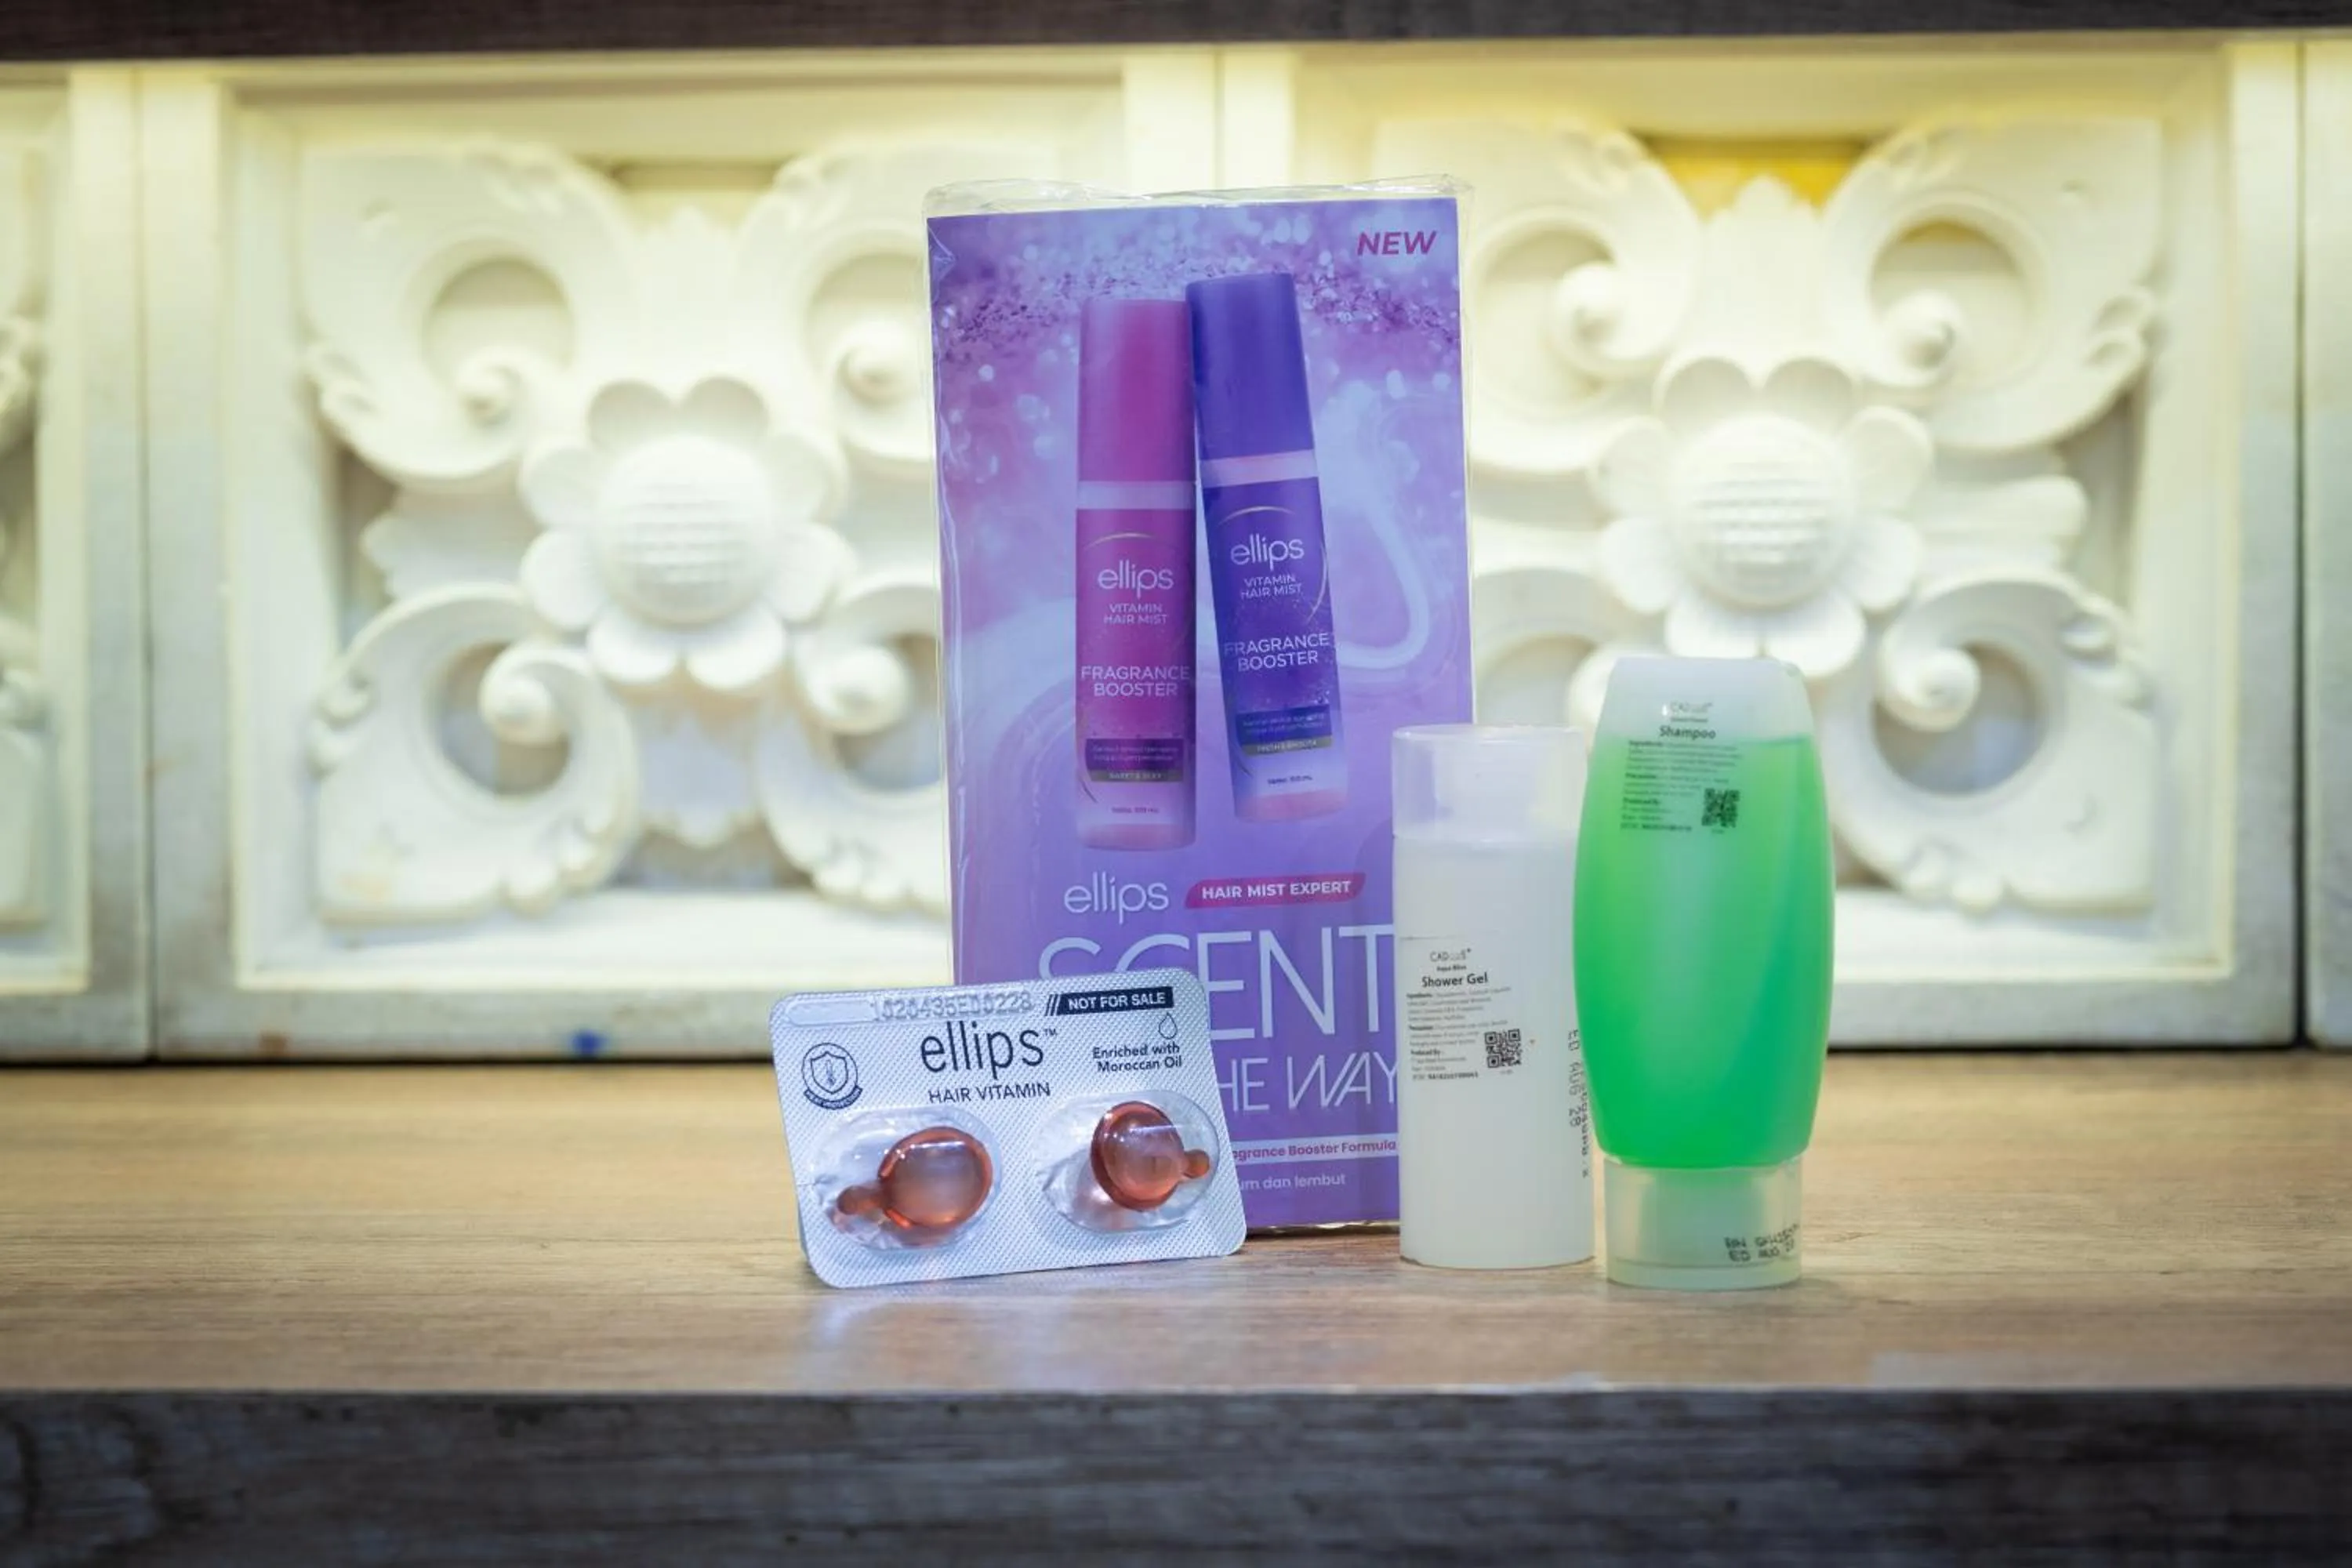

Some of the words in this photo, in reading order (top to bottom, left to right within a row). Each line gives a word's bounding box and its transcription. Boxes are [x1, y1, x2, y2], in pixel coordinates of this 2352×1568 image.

[1357, 231, 1436, 256] NEW
[1230, 534, 1305, 571] ellips
[1098, 560, 1174, 598] ellips
[1244, 574, 1297, 587] VITAMIN
[1241, 587, 1271, 599] HAIR
[1274, 585, 1301, 596] MIST
[1109, 603, 1163, 613] VITAMIN
[1104, 615, 1134, 625] HAIR
[1138, 614, 1167, 624] MIST
[1225, 633, 1330, 655] FRAGRANCE
[1238, 651, 1319, 671] BOOSTER
[1081, 666, 1190, 680] FRAGRANCE
[1094, 683, 1177, 696] BOOSTER
[1660, 725, 1716, 740] Shampoo
[1064, 871, 1170, 924] ellips
[1202, 887, 1242, 899] HAIR
[1247, 884, 1284, 898] MIST
[1290, 880, 1352, 895] EXPERT
[1421, 976, 1462, 987] Shower
[1467, 971, 1488, 984] Gel
[1068, 997, 1096, 1010] NOT
[1101, 995, 1128, 1008] FOR
[1131, 992, 1166, 1005] SALE
[920, 1021, 1044, 1080] ellips
[1093, 1044, 1148, 1058] Enriched
[1152, 1042, 1180, 1054] with
[1098, 1060, 1160, 1073] Moroccan
[1164, 1055, 1181, 1068] Oil
[1287, 1052, 1398, 1109] WAY
[928, 1087, 971, 1103] HAIR
[976, 1082, 1051, 1100] VITAMIN
[1288, 1145, 1338, 1157] Booster
[1341, 1139, 1396, 1152] Formula
[1263, 1176, 1291, 1189] dan
[1295, 1174, 1346, 1187] lembut
